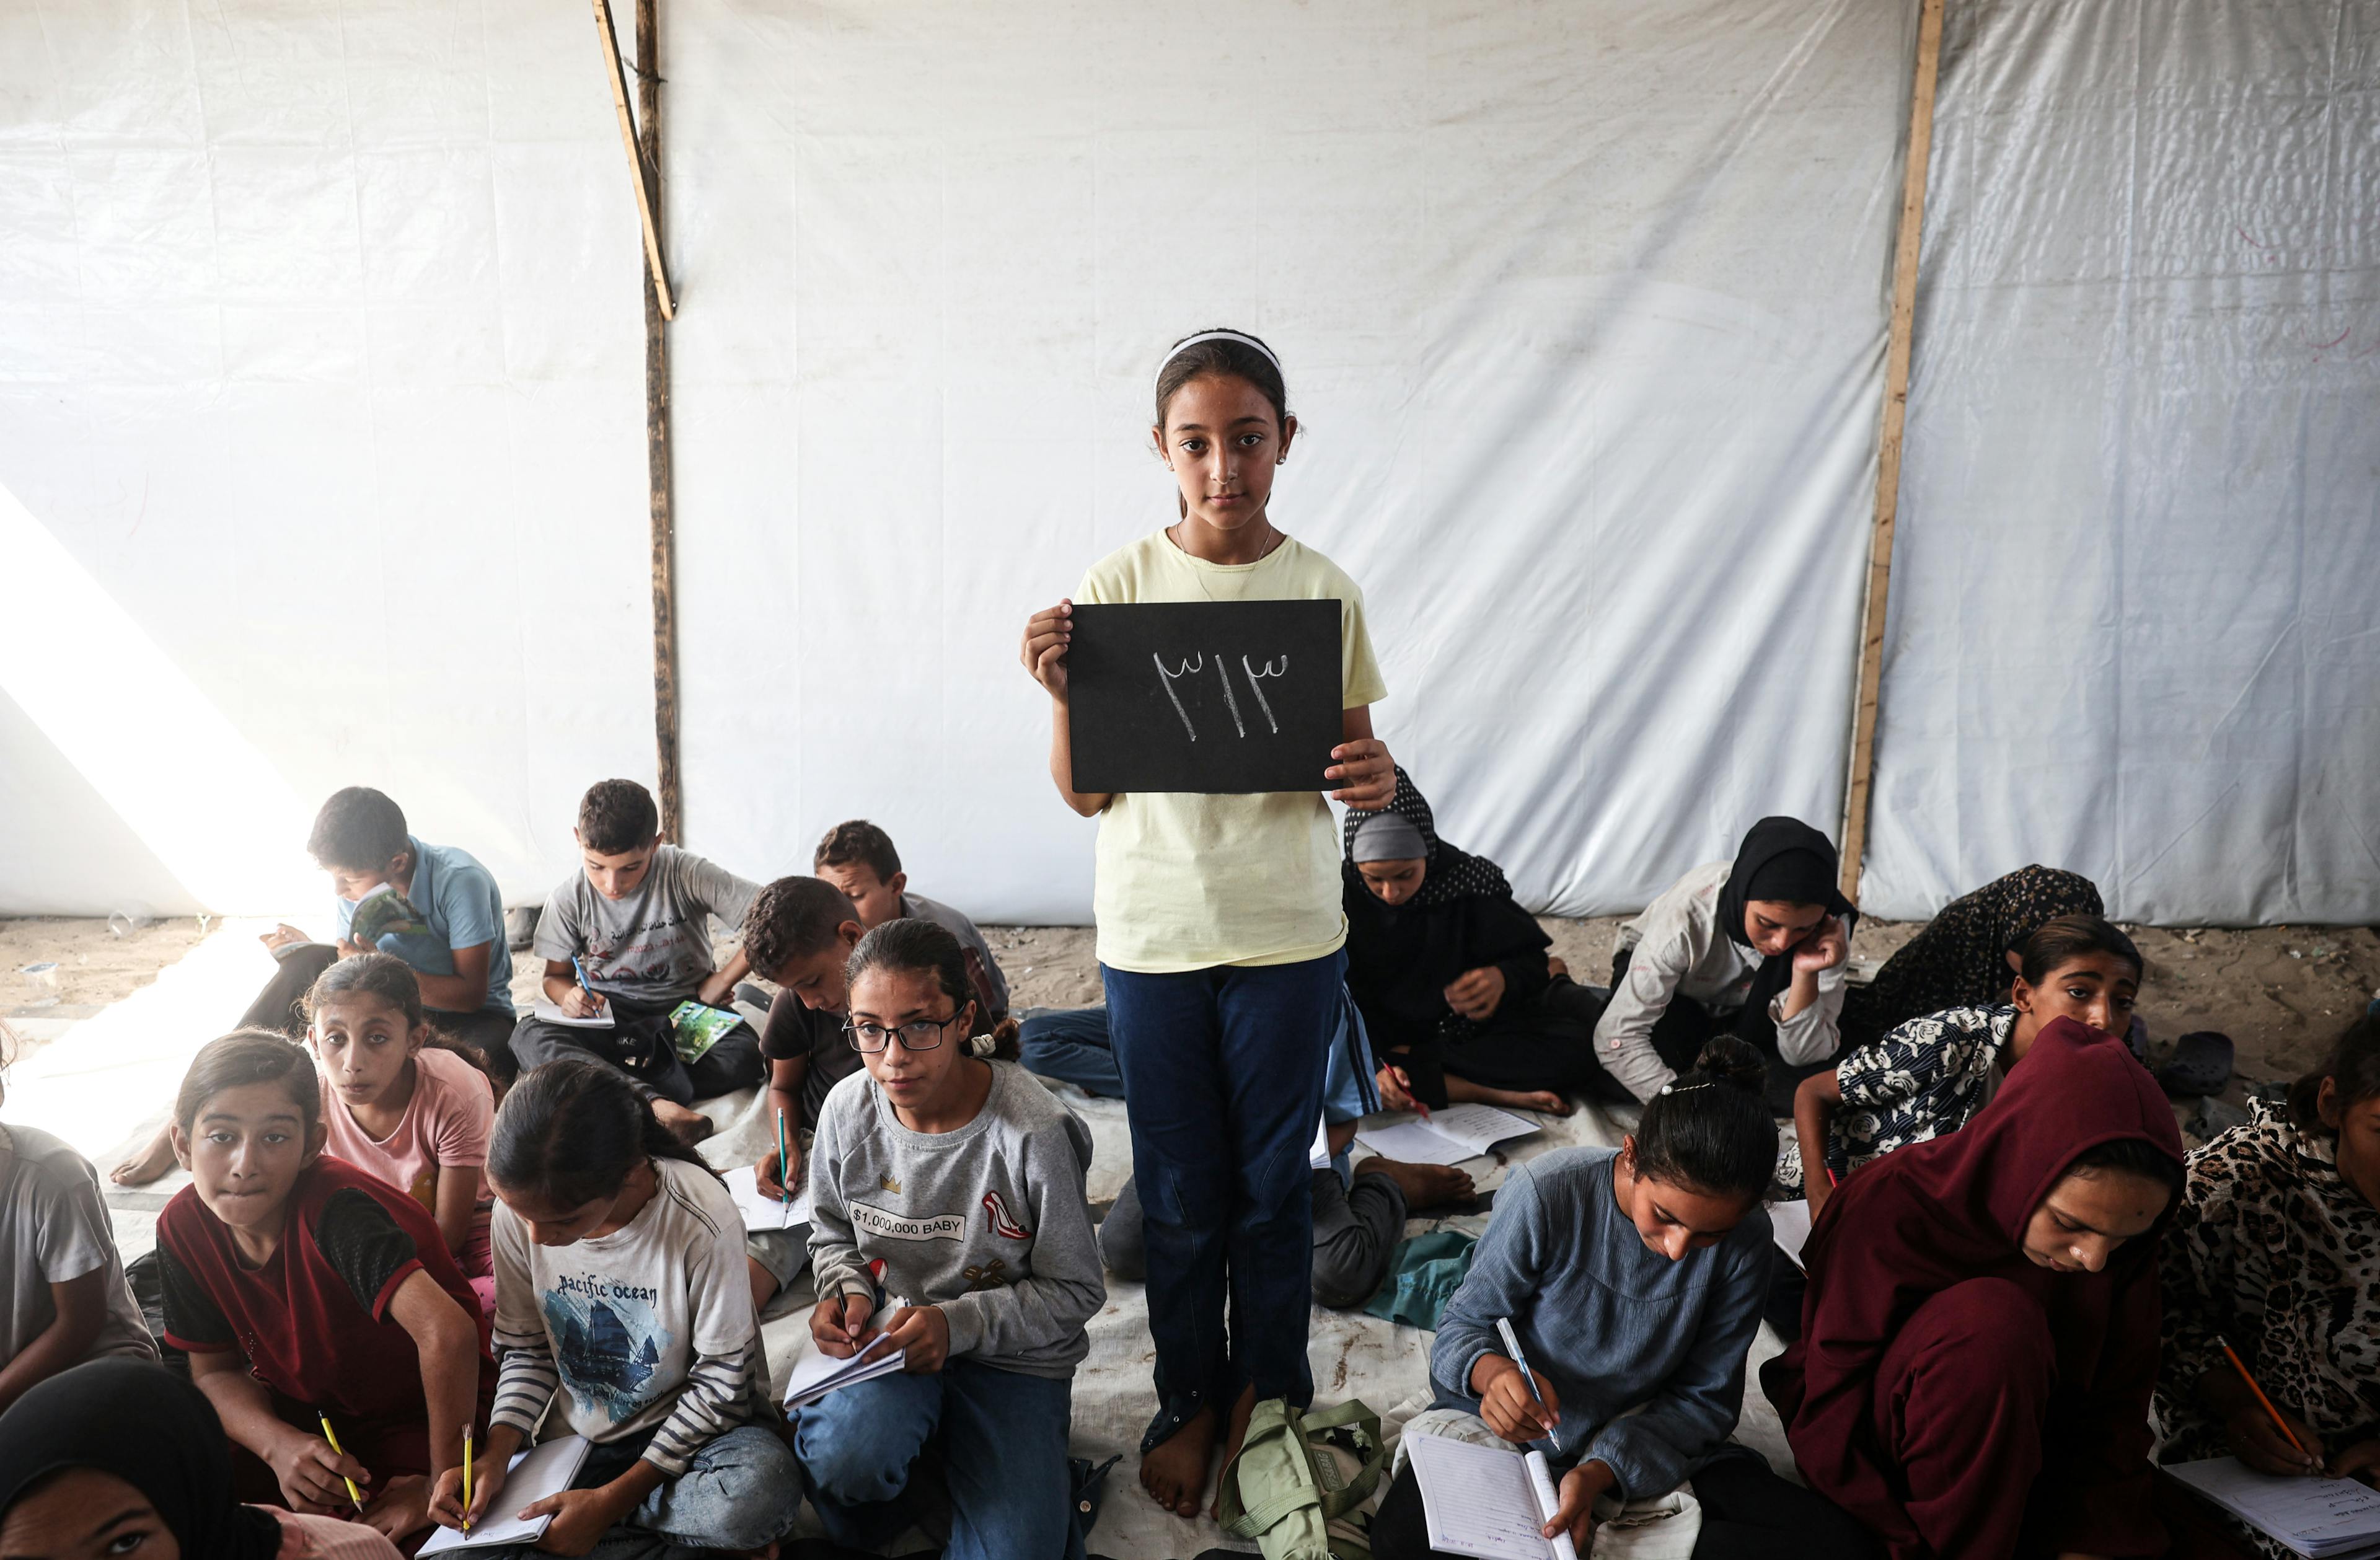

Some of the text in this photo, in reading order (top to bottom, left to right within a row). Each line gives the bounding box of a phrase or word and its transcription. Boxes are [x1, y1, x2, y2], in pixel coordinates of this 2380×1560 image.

[1153, 651, 1289, 742] ٣١٣
[853, 1209, 961, 1235] $1,000,000 BABY
[612, 1285, 658, 1309] ocean
